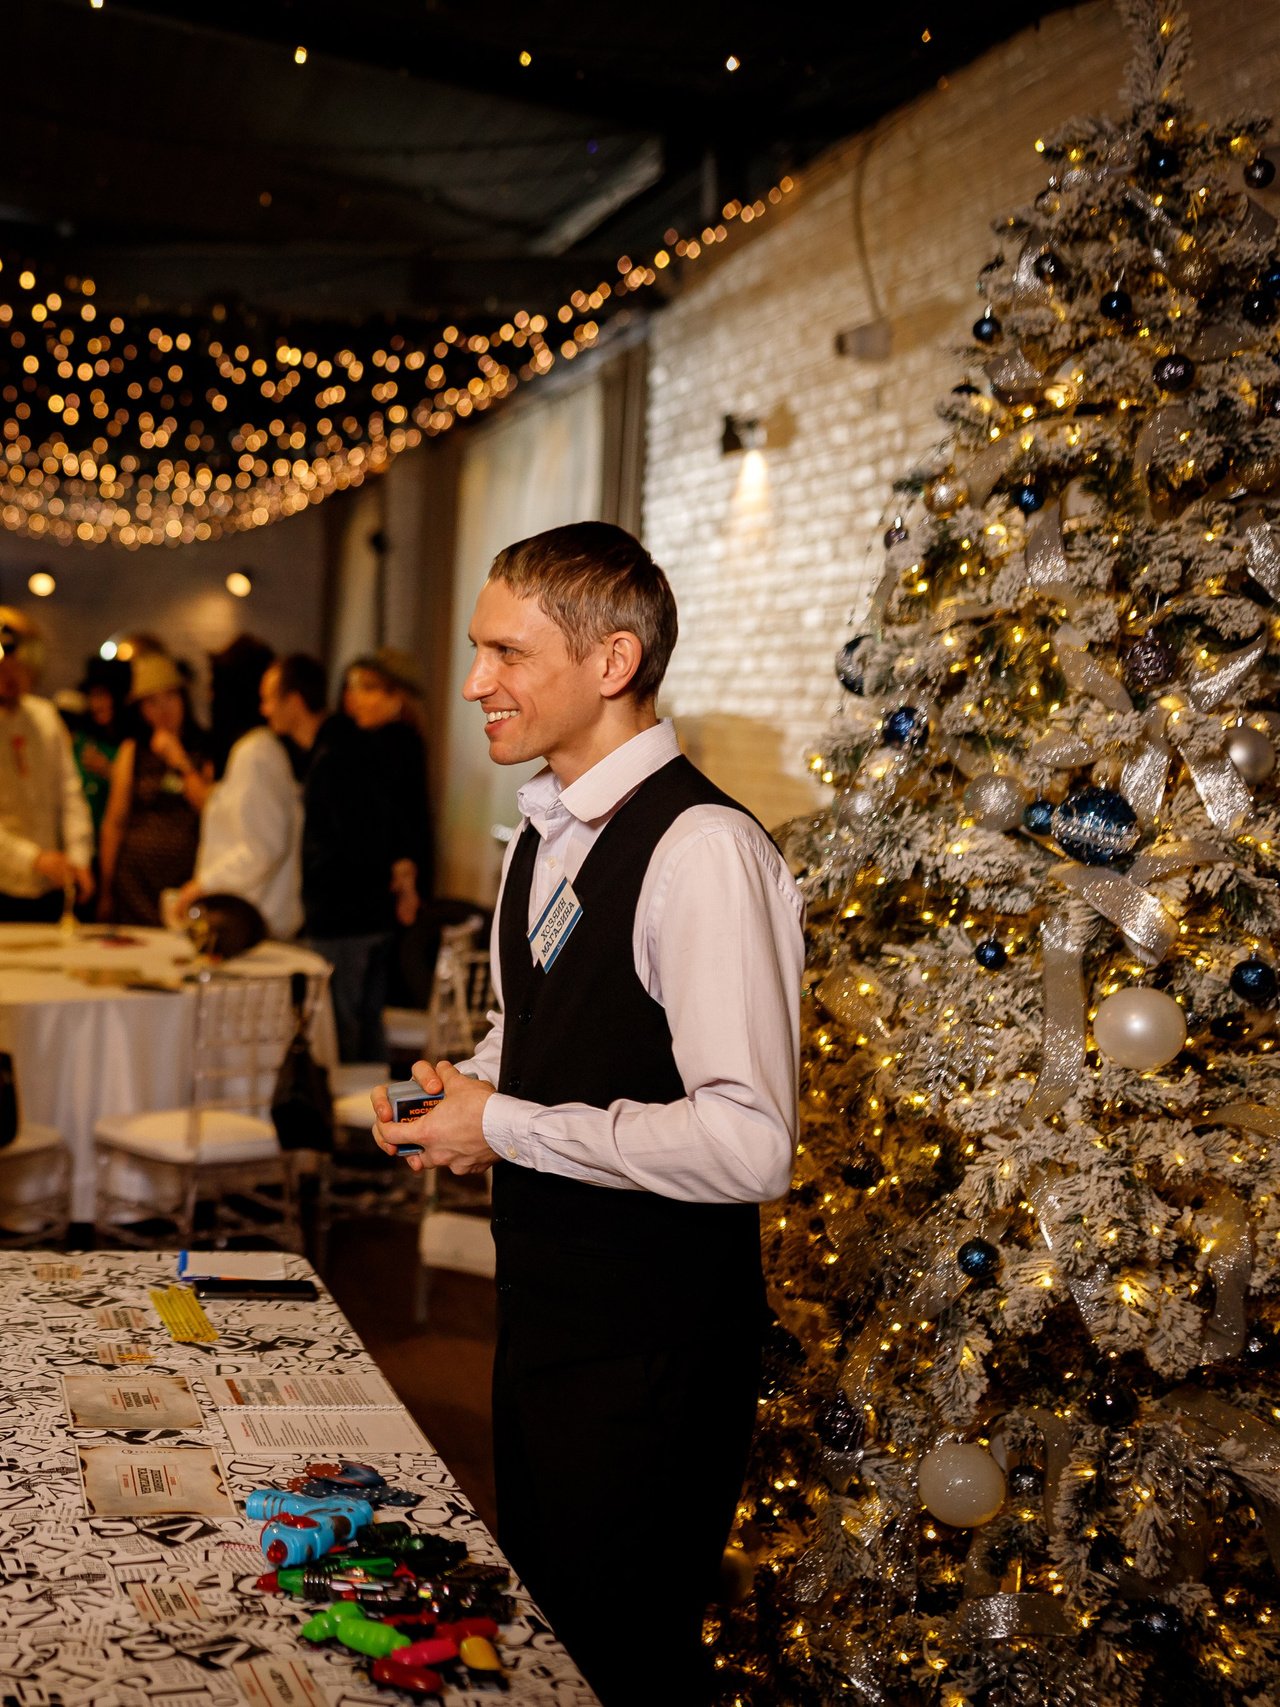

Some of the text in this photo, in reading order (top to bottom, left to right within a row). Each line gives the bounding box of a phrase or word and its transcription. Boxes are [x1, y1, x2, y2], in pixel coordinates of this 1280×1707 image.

[540, 897, 566, 942] ХОЗЯИН
[541, 901, 575, 957] МАГАЗИНА
[423, 1099, 442, 1107] ПЕР
